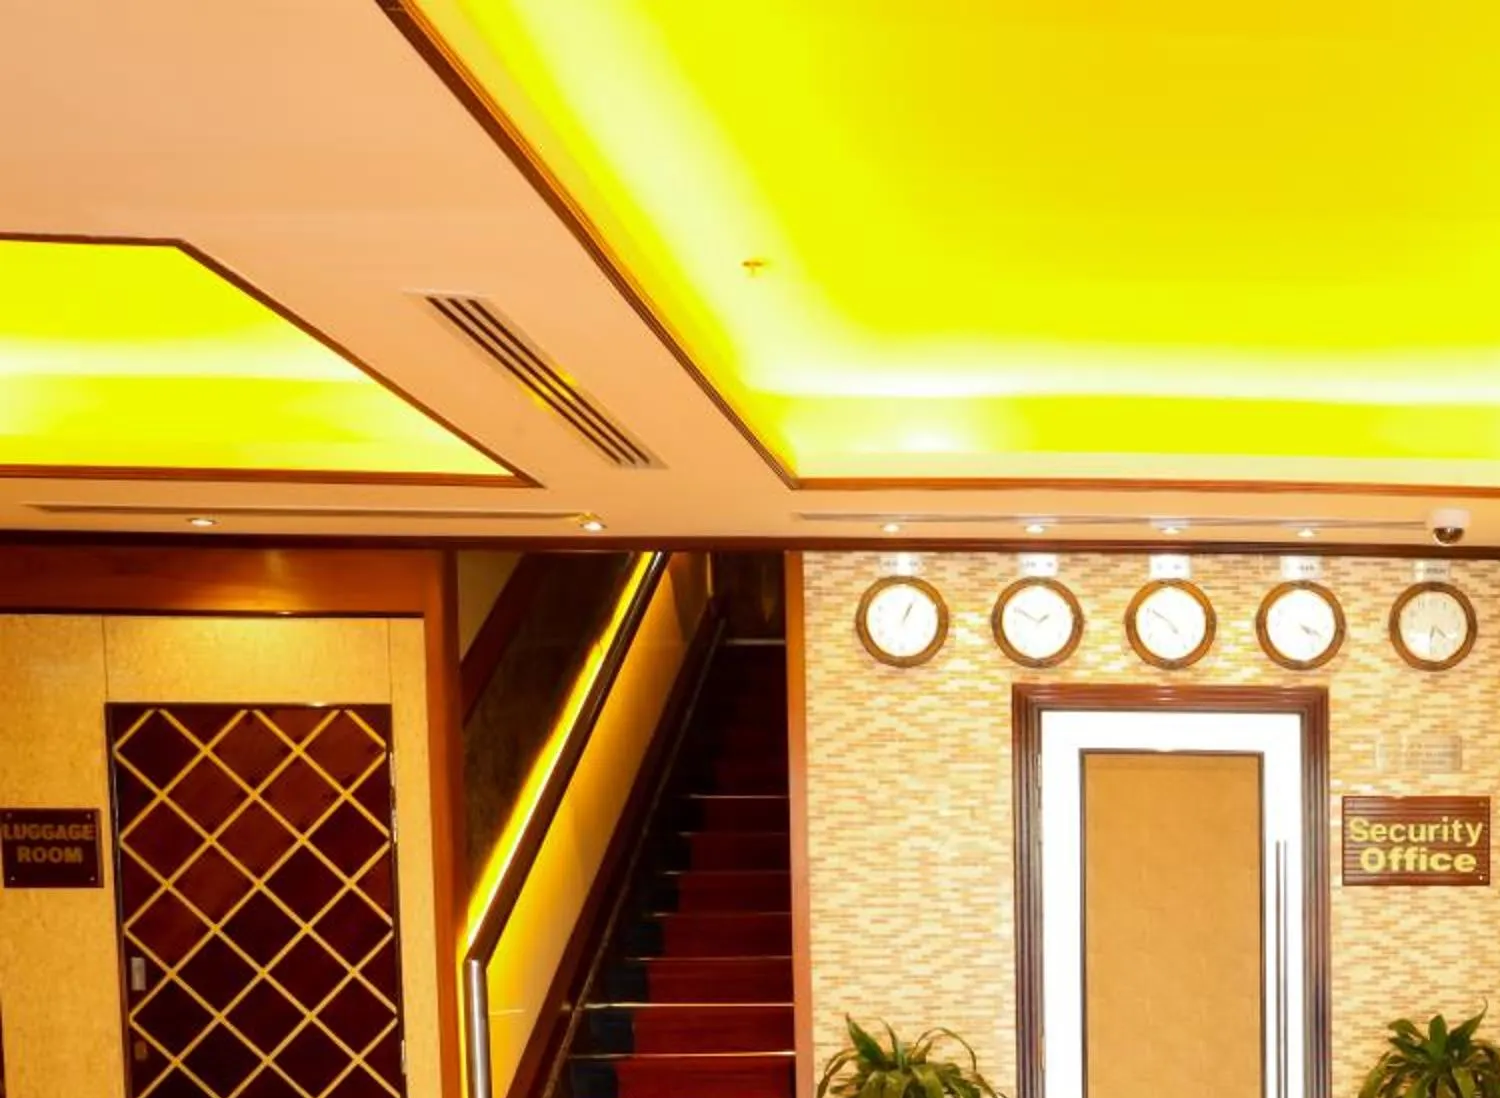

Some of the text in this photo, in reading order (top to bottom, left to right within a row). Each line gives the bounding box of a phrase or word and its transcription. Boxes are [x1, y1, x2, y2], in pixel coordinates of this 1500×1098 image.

[2, 822, 94, 841] LUGGAGE
[1349, 815, 1483, 847] Security
[17, 846, 83, 864] ROOM
[1360, 846, 1477, 874] Office
